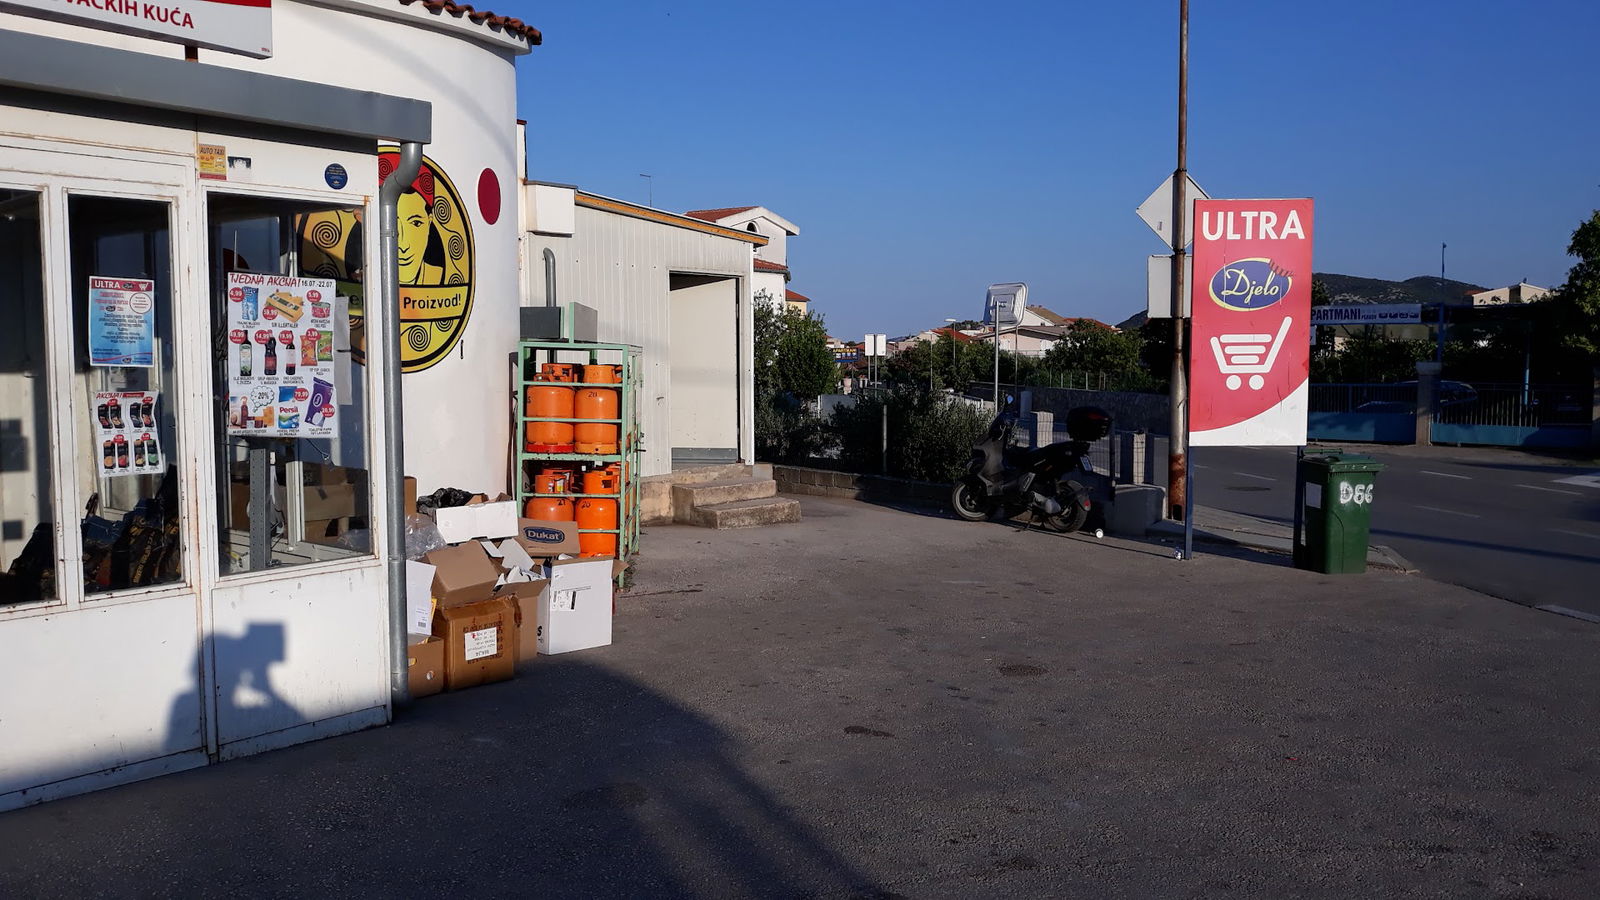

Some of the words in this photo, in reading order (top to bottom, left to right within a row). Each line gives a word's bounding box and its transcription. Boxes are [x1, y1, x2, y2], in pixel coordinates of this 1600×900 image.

[144, 4, 194, 29] KUĆA
[1202, 209, 1305, 241] ULTRA
[94, 280, 121, 289] ULTRA
[229, 273, 265, 285] TJEDNA
[1220, 267, 1280, 304] Djelo
[403, 293, 461, 309] Proizvod!
[527, 530, 560, 540] Dukat
